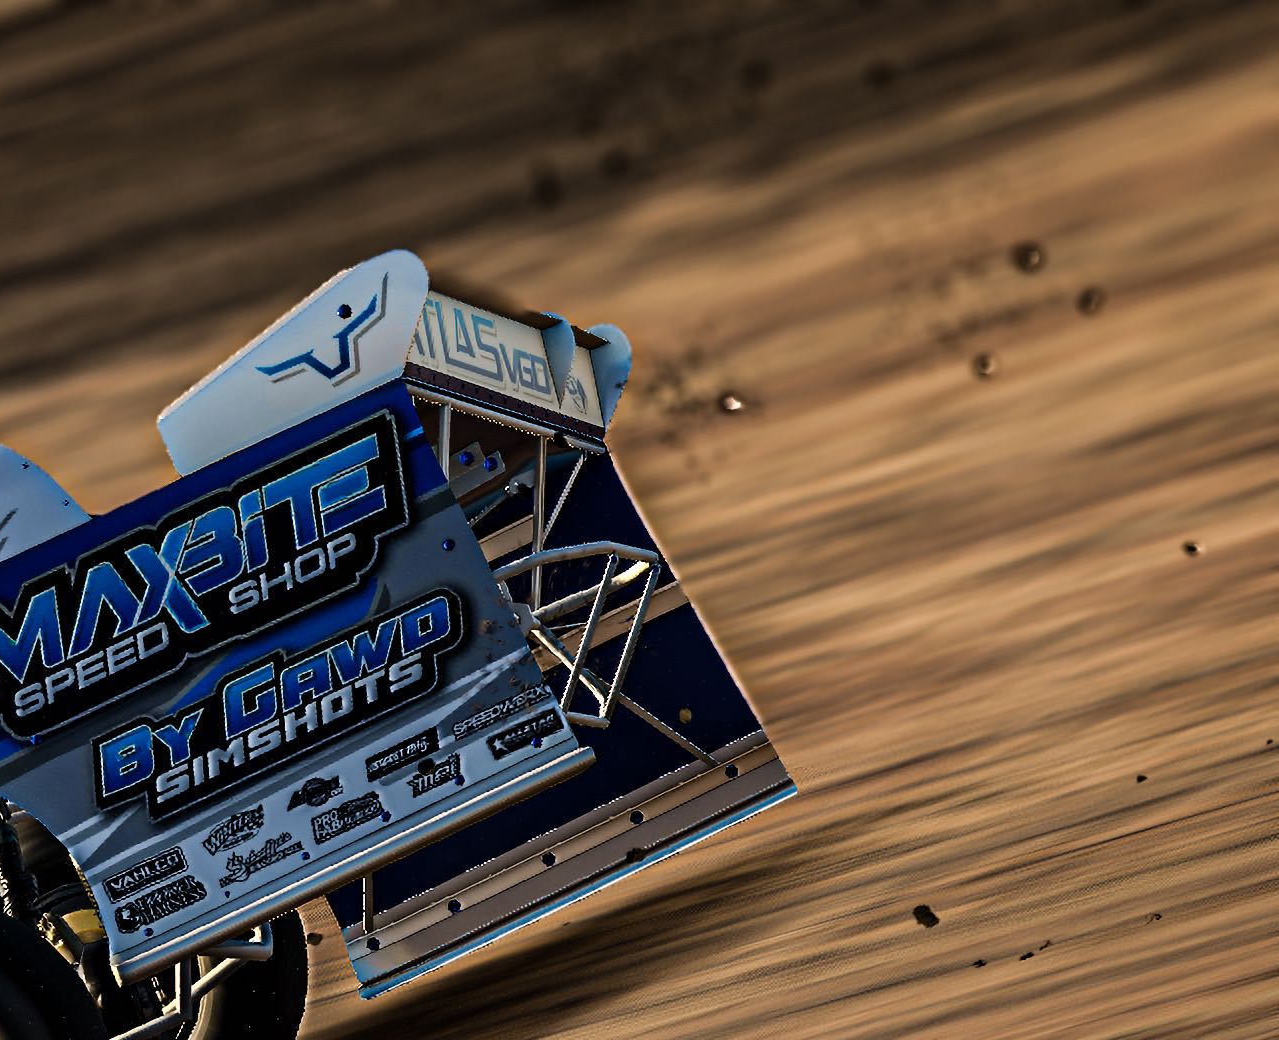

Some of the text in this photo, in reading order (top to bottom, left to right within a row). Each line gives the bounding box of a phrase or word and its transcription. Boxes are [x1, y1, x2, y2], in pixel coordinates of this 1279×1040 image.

[228, 532, 357, 615] SHOP
[15, 622, 170, 717] SPEED
[156, 651, 423, 804] SIMSHOTS
